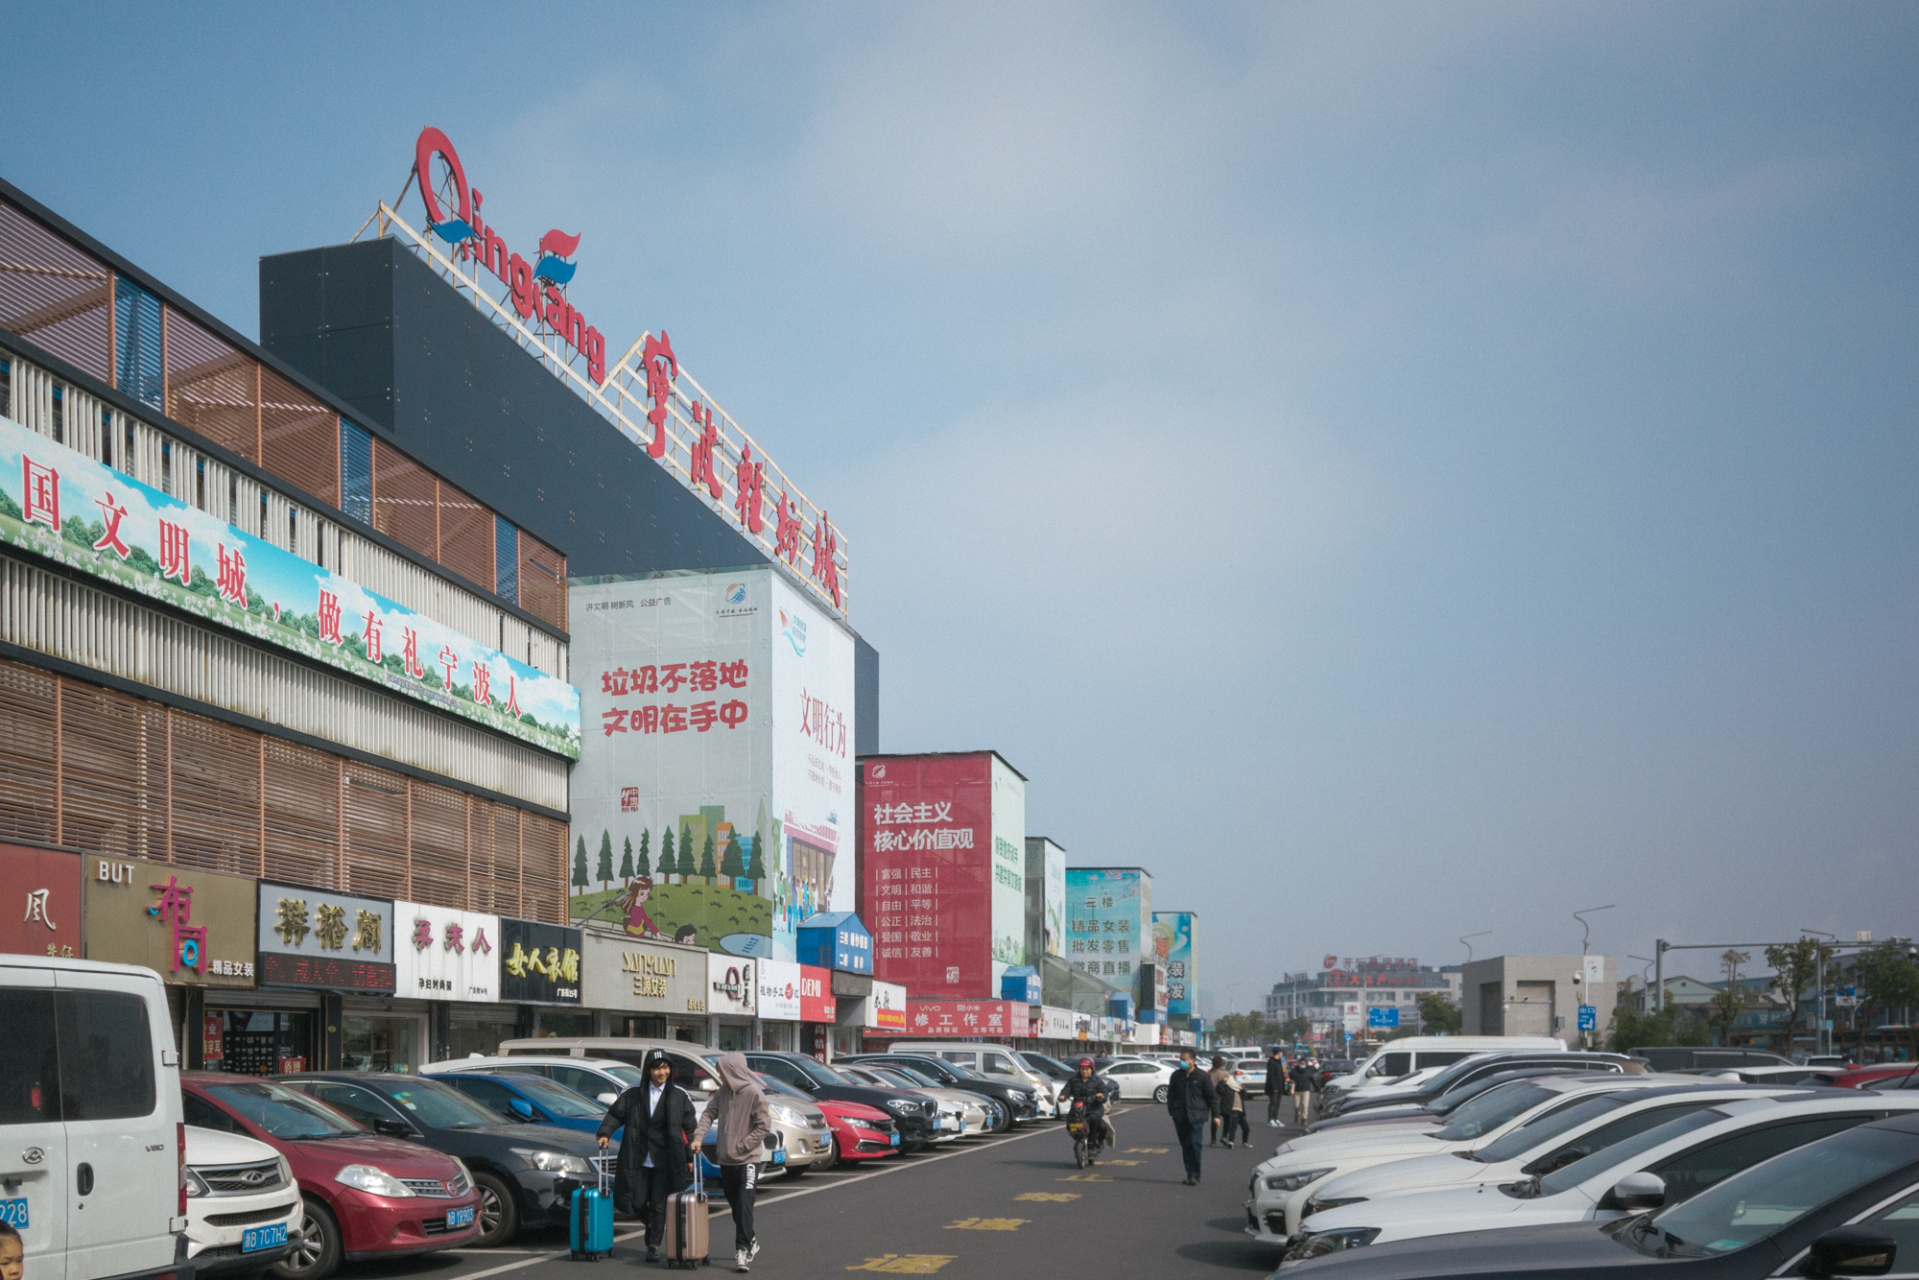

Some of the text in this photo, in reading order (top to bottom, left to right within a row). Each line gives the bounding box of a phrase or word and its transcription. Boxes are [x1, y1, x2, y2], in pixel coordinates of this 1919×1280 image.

[640, 597, 671, 607] 公益广告
[601, 658, 748, 697] 垃圾不落地
[601, 699, 749, 737] 文明在手中
[799, 686, 846, 758] 文明行为
[874, 801, 953, 825] 社会主义
[873, 828, 974, 852] 核心价值观
[99, 861, 135, 884] BUT
[881, 866, 932, 881] 富强 民主
[881, 883, 932, 896] 文明 和谐
[881, 899, 932, 912] 自由 平等
[1085, 896, 1114, 909] 三楼
[881, 914, 932, 927] 公正 法治
[1071, 919, 1130, 933] 精品女装
[412, 919, 492, 953] 孕夫人
[881, 930, 932, 943] 爱国 敬业
[881, 946, 932, 958] 诚信 友善
[1071, 939, 1130, 953] 批发零售
[212, 959, 254, 978] 精品女装
[506, 942, 580, 983] 女人衣馆
[801, 977, 821, 998] DEMI
[914, 1013, 1003, 1027] 修工作室
[746, 1163, 756, 1189] CHINA
